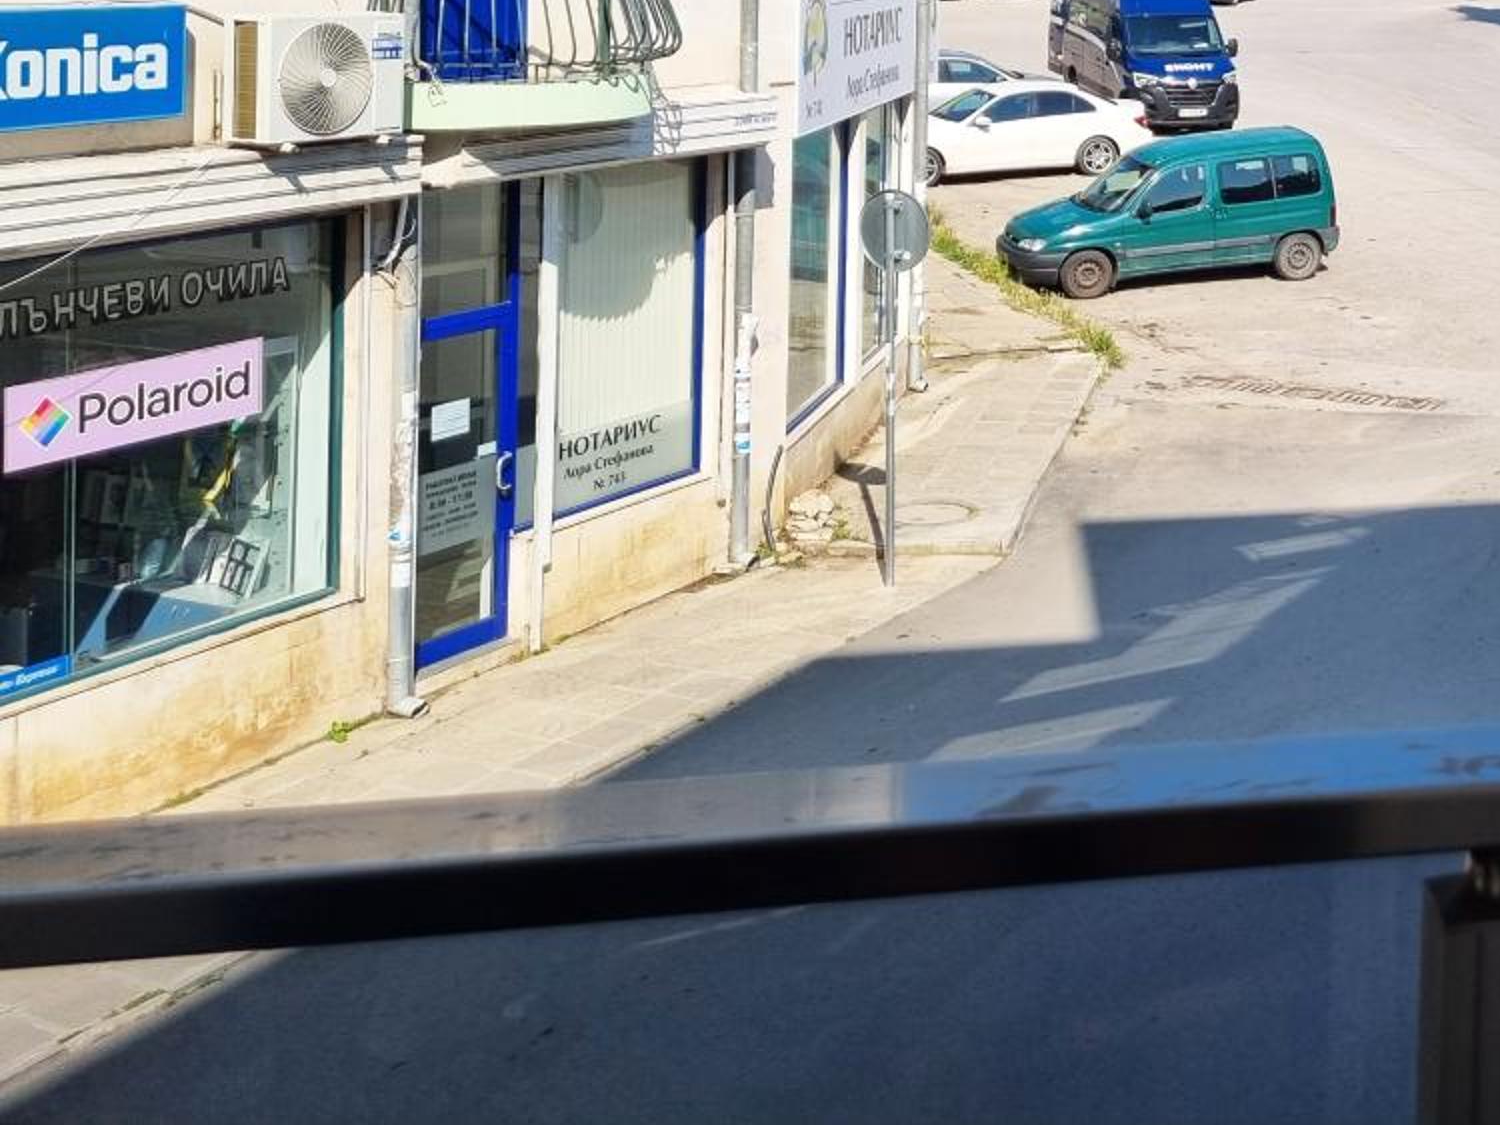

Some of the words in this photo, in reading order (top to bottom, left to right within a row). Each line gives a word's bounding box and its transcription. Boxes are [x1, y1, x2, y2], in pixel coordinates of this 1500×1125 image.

[181, 257, 291, 306] ОЧИЛА
[78, 361, 251, 434] Polaroid
[559, 414, 662, 462] НОТАРИУС
